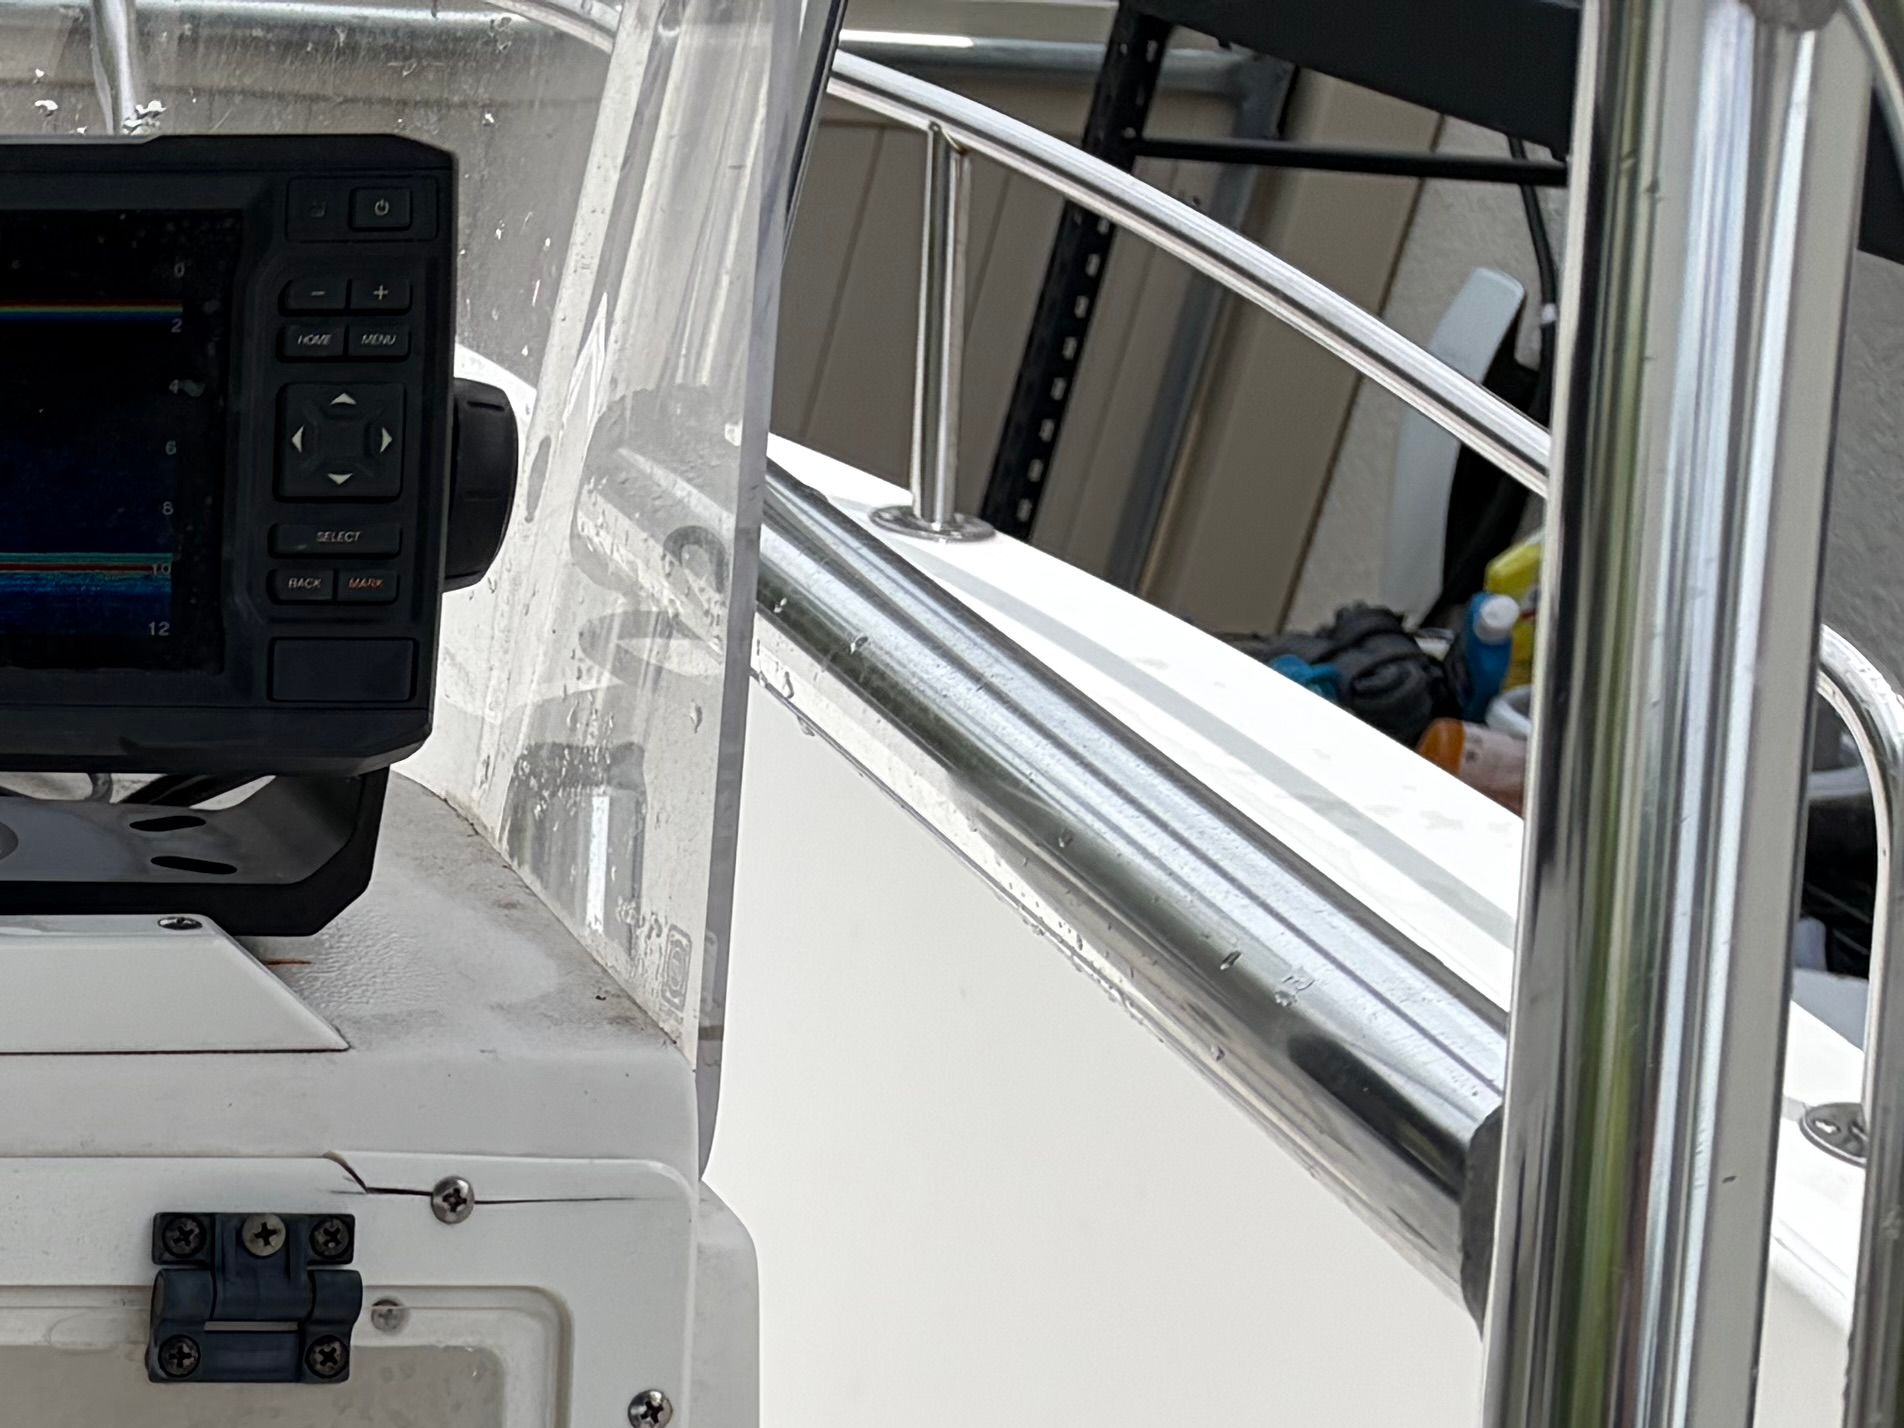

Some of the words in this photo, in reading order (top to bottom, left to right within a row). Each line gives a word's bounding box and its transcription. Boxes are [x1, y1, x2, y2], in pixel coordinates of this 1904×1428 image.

[171, 318, 183, 333] 2
[297, 334, 333, 346] HOME
[361, 334, 397, 346] MENU
[169, 379, 179, 394] 4
[165, 440, 176, 455] 6
[162, 501, 174, 515] 8
[316, 531, 361, 543] SELECT
[152, 563, 171, 576] 10
[288, 577, 322, 589] BACK
[348, 577, 385, 589] MARK
[149, 621, 170, 636] 12
